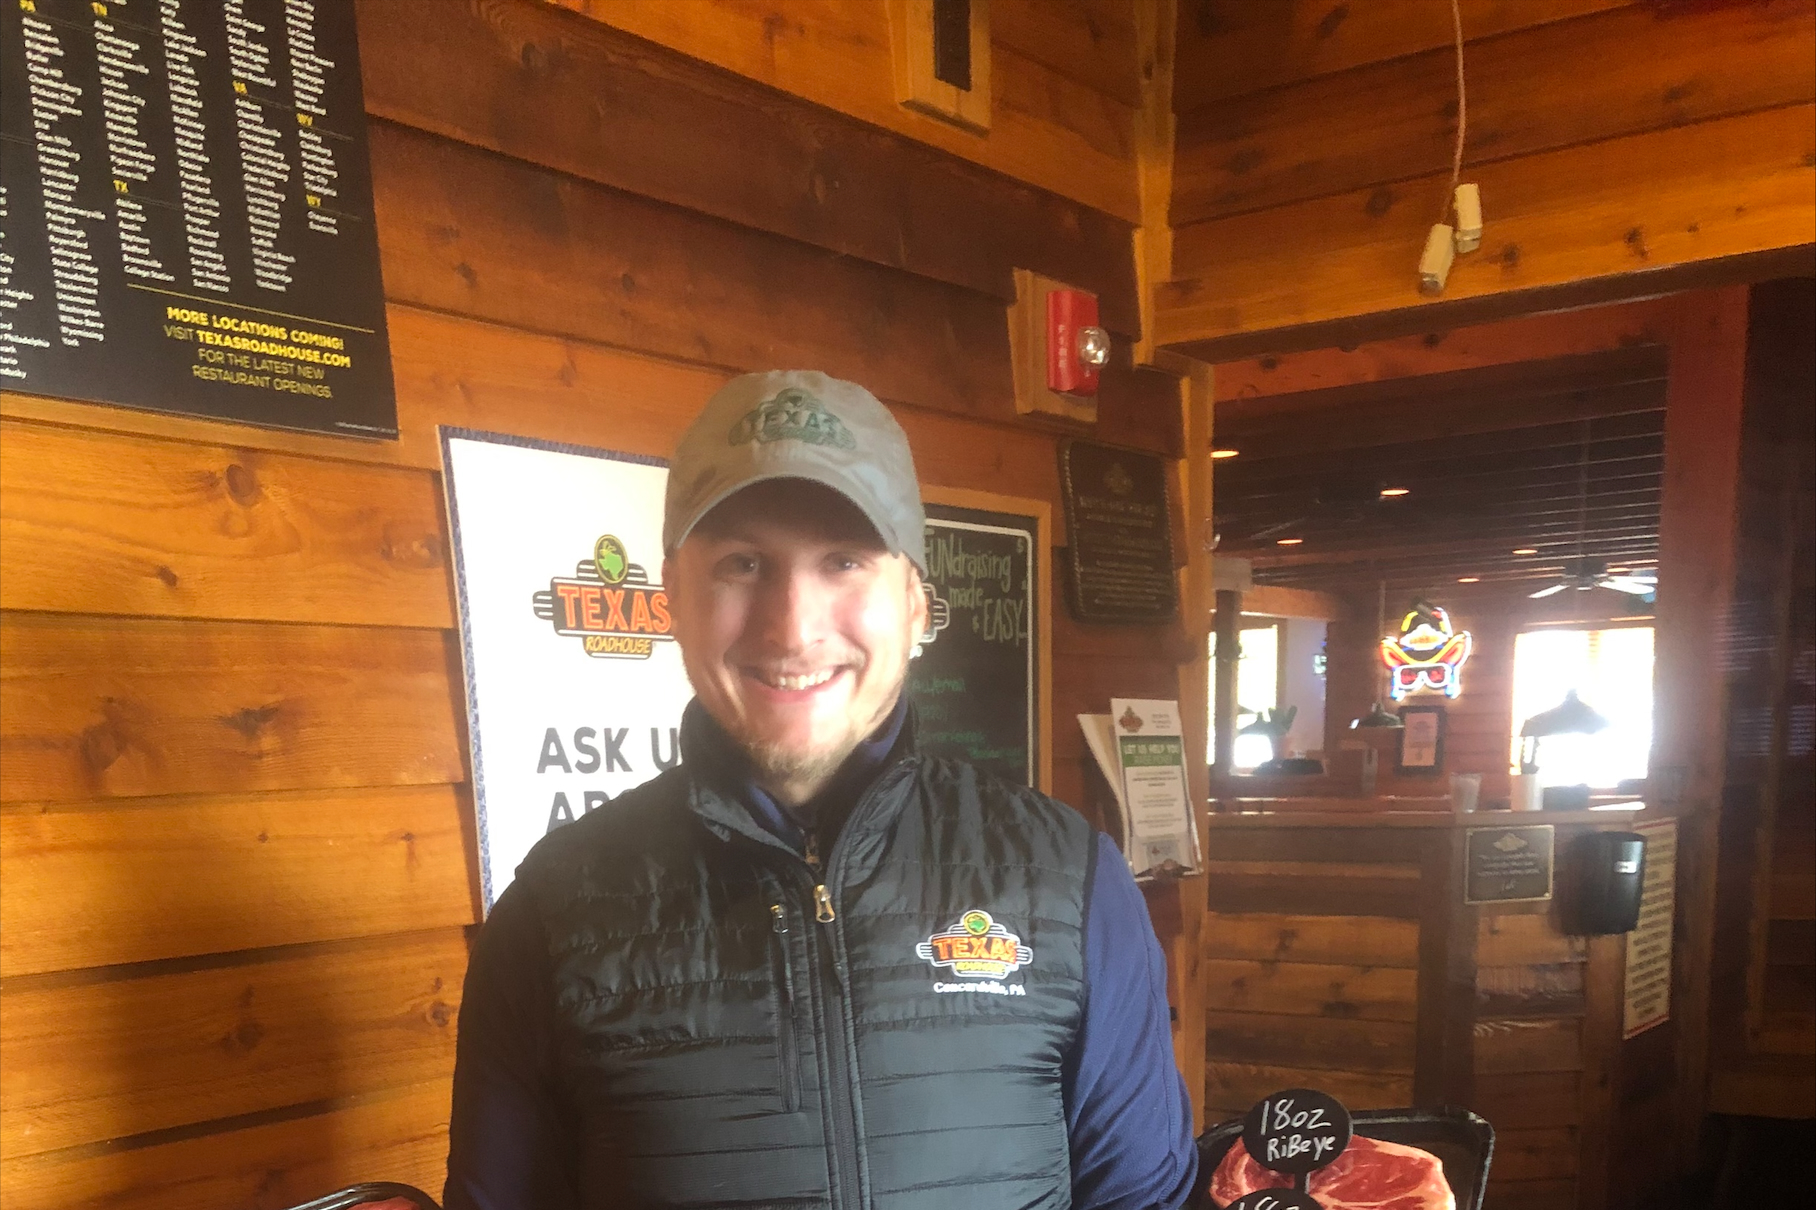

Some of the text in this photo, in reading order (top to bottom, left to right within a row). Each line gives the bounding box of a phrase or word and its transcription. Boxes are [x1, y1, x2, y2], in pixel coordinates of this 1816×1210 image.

[113, 179, 130, 194] TX
[167, 306, 344, 350] MORE LOCATIONS COMING!
[163, 324, 351, 368] VISIT TEXASROADHOUSE.COM
[192, 365, 271, 389] RESTAURANT
[198, 348, 324, 380] FOR THE LATEST NEW
[741, 407, 839, 440] TEXAS
[557, 584, 672, 634] TEXAS
[949, 579, 984, 611] made
[585, 636, 651, 655] ROADHOUSE
[537, 726, 680, 774] ASK U
[932, 936, 1017, 965] TEXAS
[1009, 984, 1026, 996] PA
